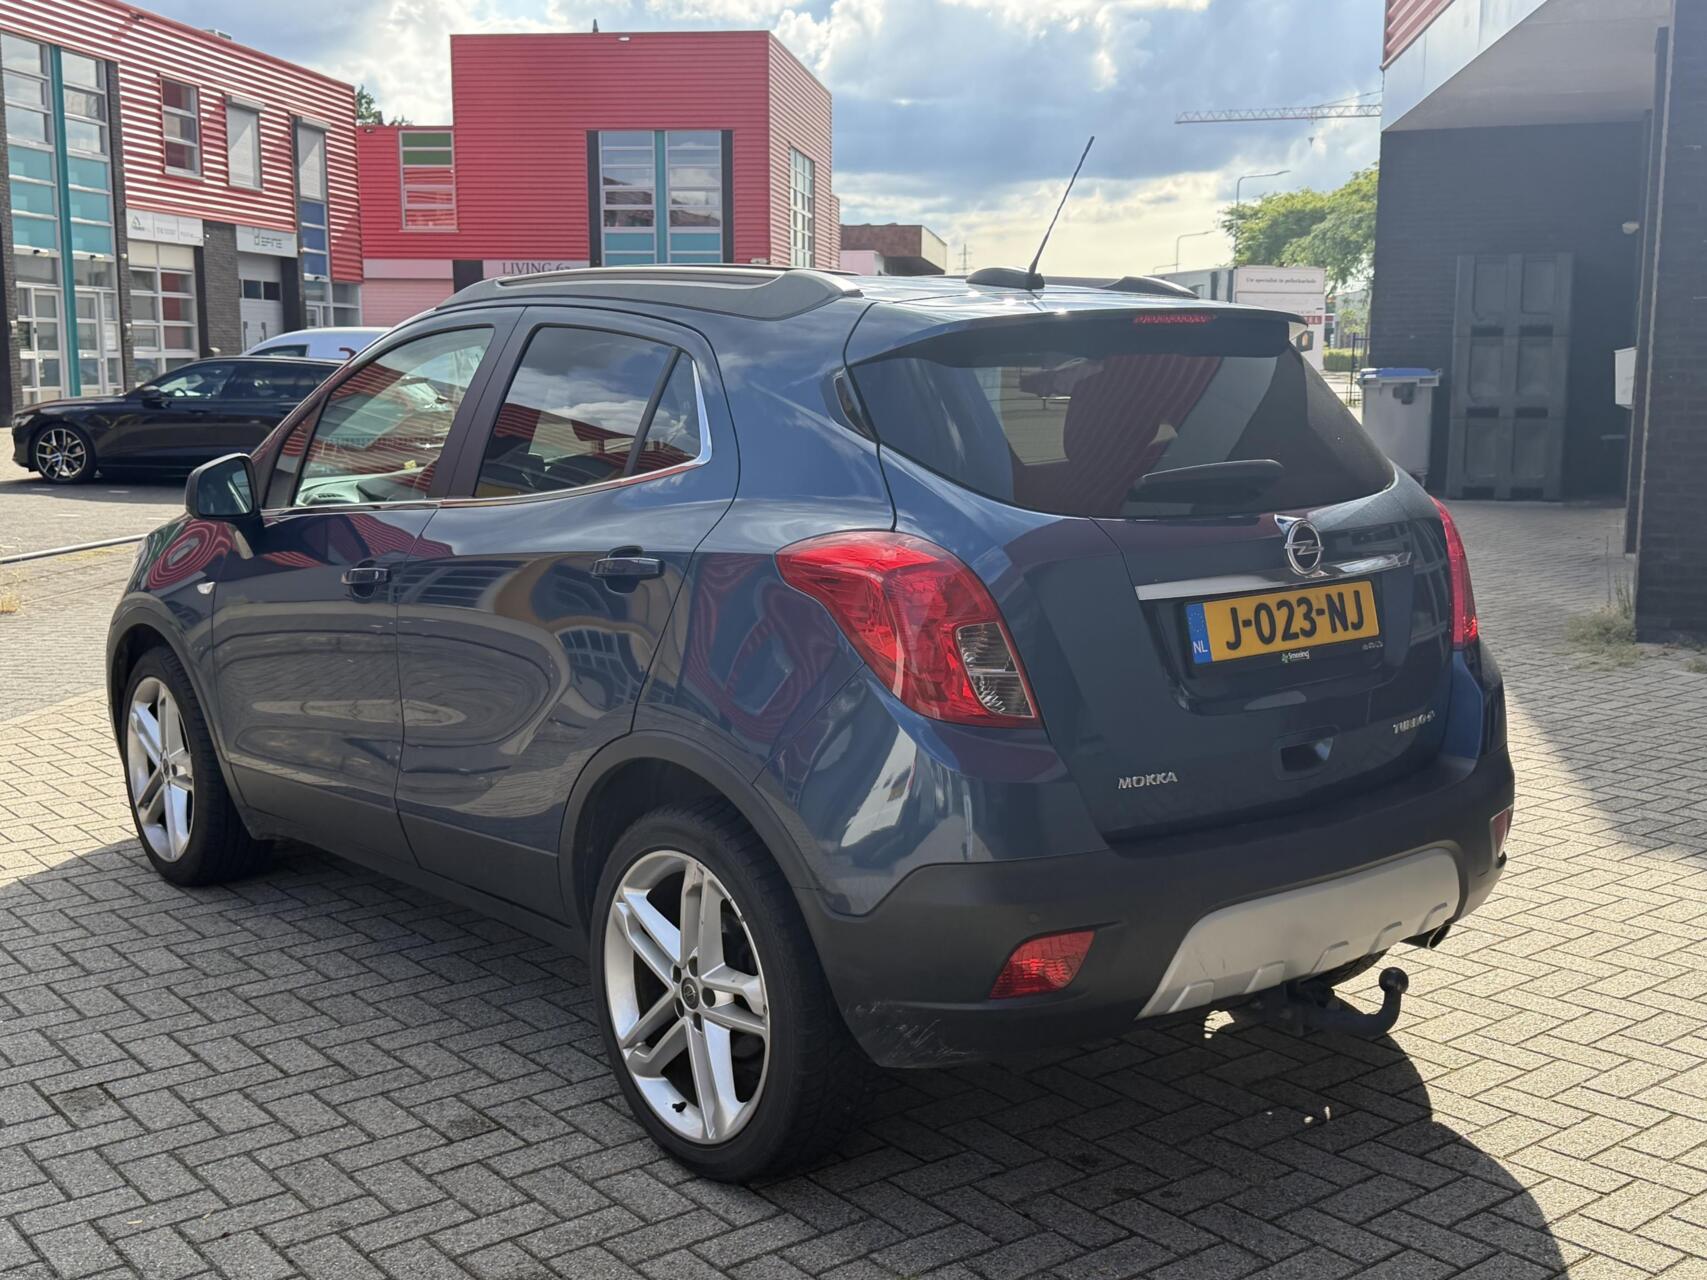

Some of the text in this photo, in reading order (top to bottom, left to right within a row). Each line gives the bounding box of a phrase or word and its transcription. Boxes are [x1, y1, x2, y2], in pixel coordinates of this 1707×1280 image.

[501, 262, 552, 274] LIVING
[1225, 590, 1364, 651] J-023-NJ
[1192, 640, 1208, 655] NL
[1118, 771, 1178, 789] MOKKA
